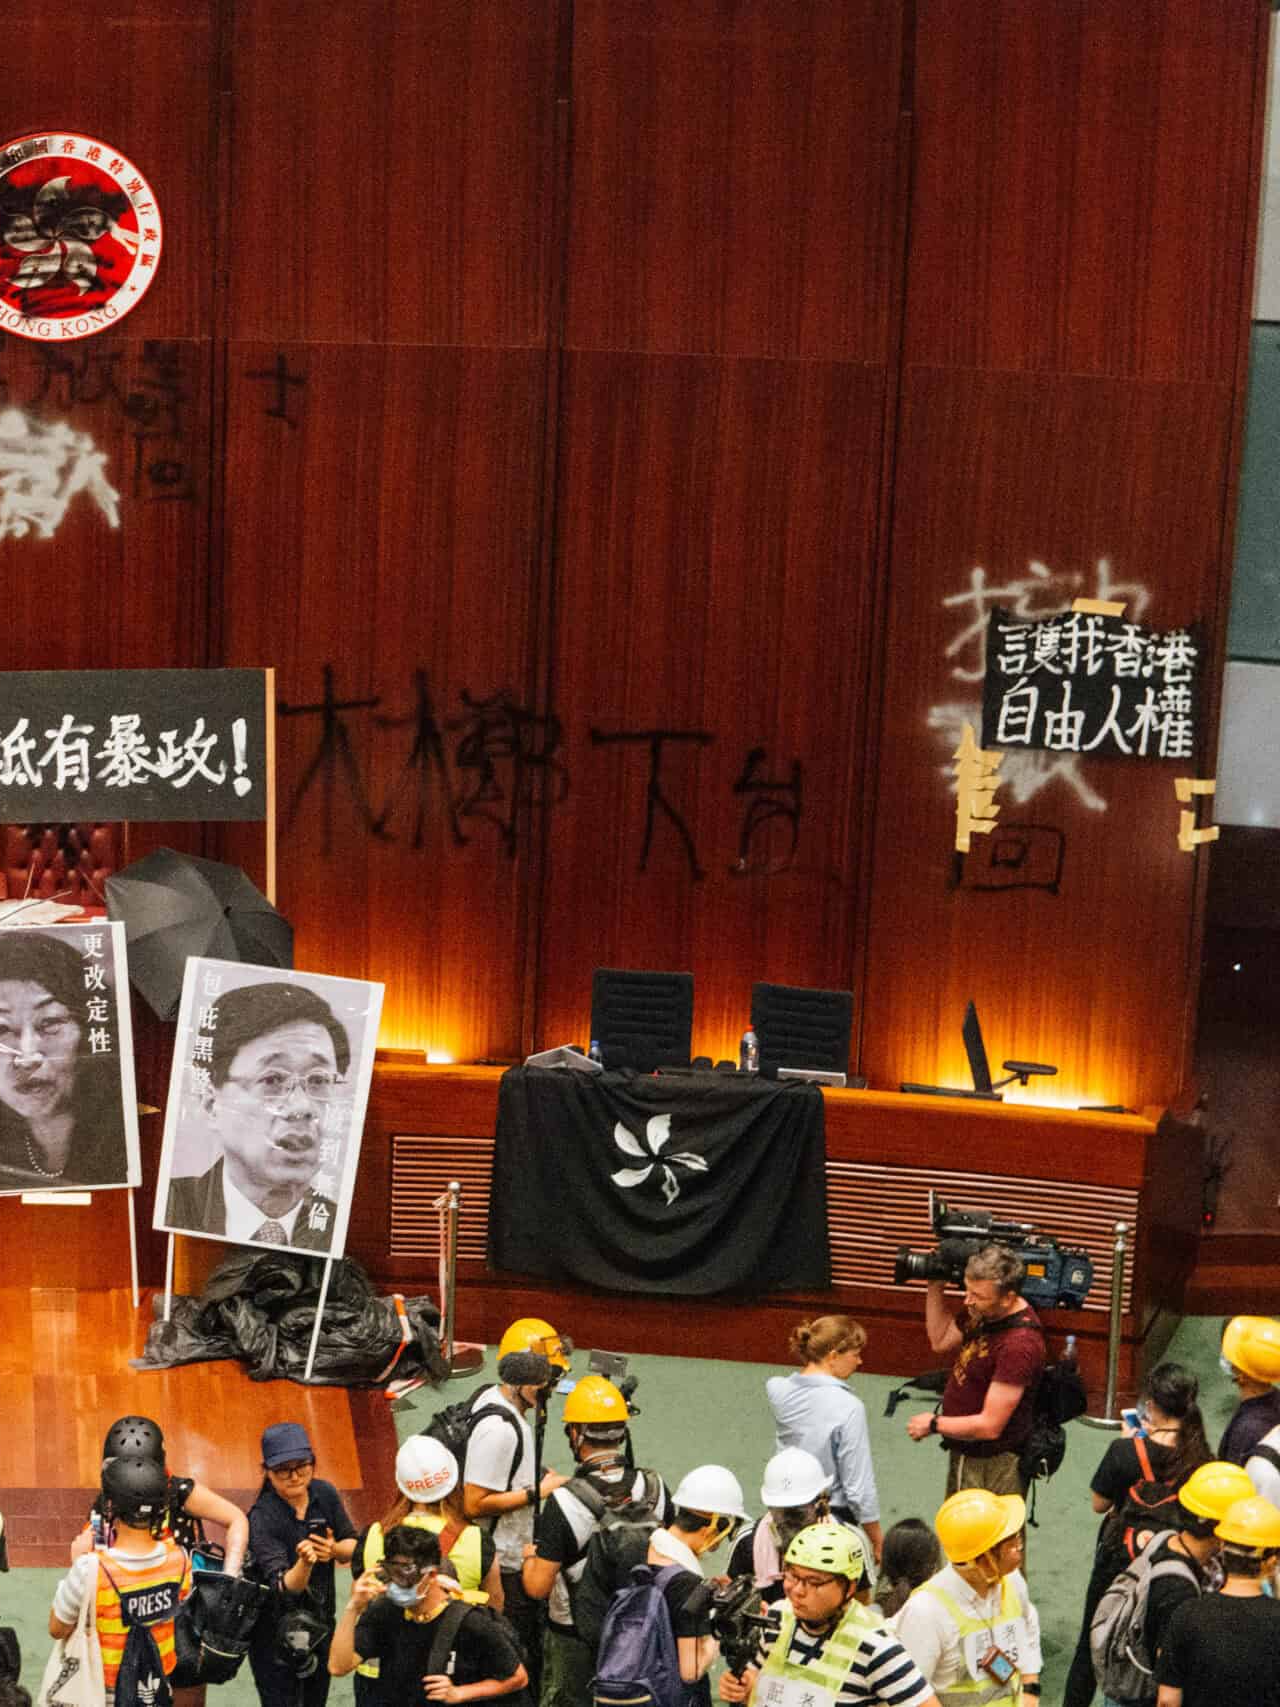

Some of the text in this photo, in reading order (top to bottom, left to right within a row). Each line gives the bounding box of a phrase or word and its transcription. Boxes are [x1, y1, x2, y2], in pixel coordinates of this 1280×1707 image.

[59, 303, 119, 337] KONG
[997, 613, 1199, 684] 護我香港
[996, 677, 1194, 759] 自由人權
[82, 932, 113, 1054] 更改定性
[407, 1468, 450, 1493] PRESS
[128, 1589, 172, 1617] PRESS
